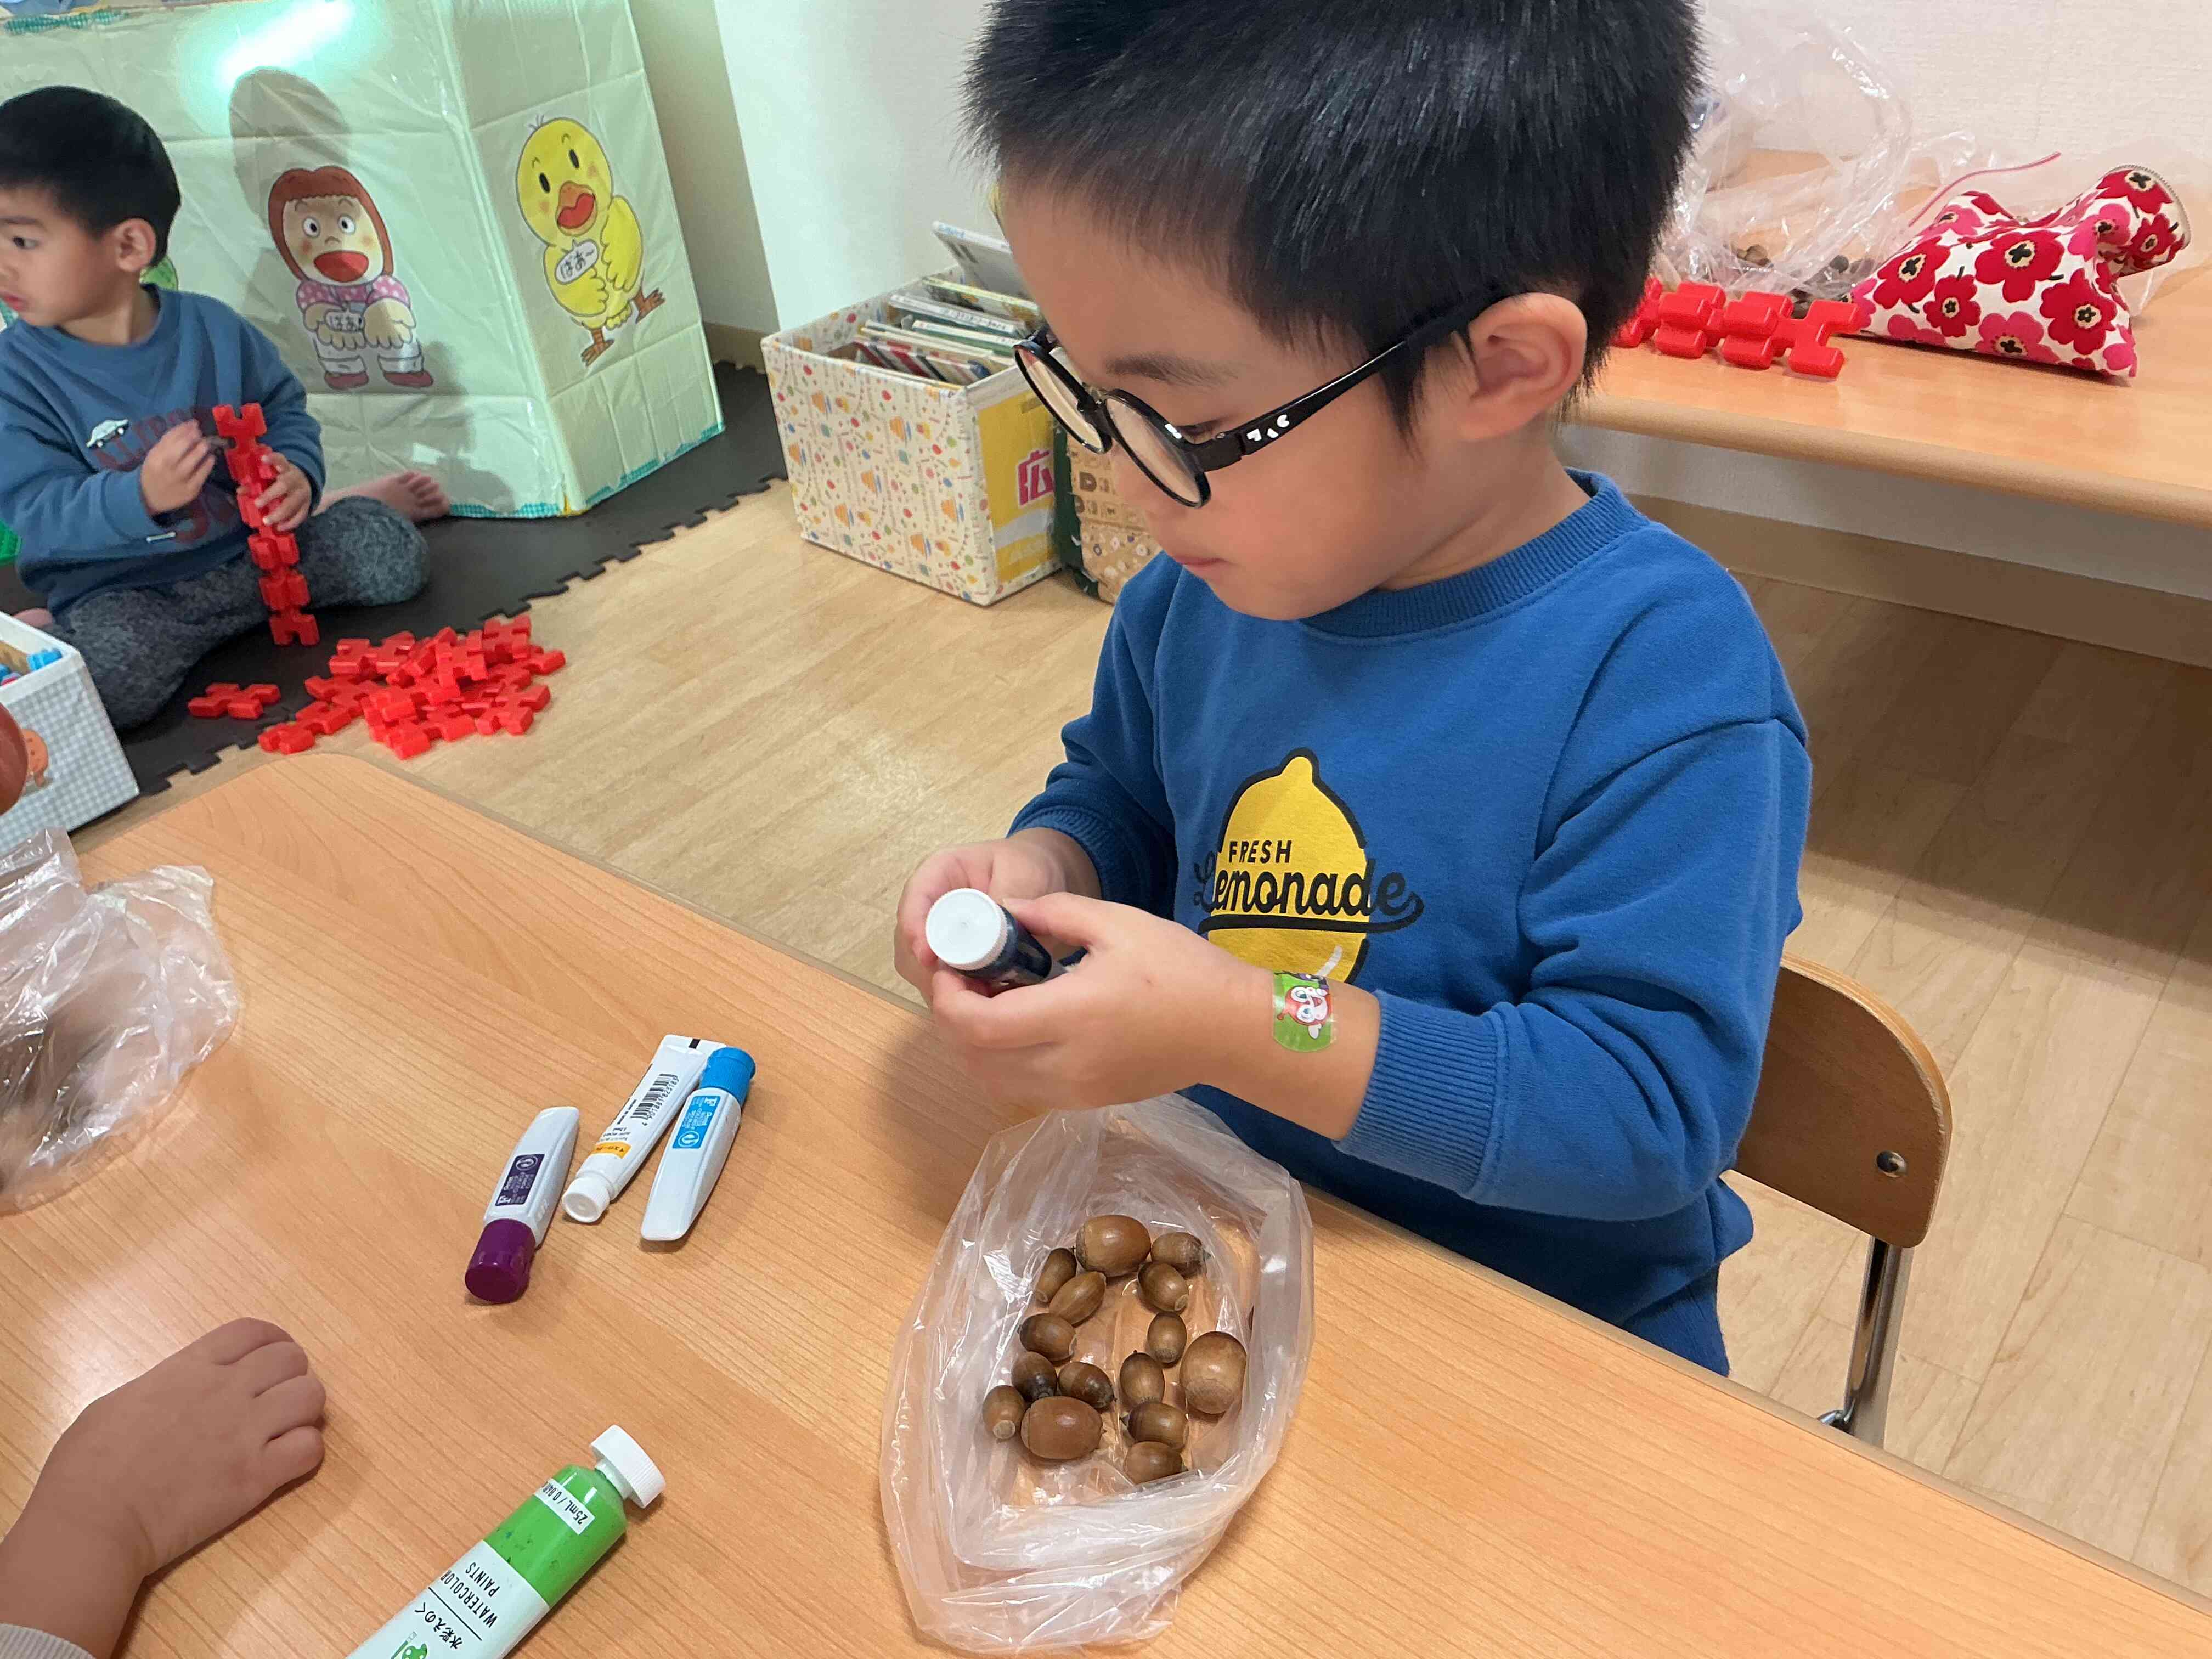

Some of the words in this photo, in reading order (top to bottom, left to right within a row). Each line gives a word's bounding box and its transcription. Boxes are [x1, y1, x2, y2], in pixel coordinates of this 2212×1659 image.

[1229, 840, 1292, 864] FRESH
[564, 1500, 588, 1525] 25mL
[465, 1562, 500, 1598] PAINTS
[441, 1570, 498, 1628] WATERCOLOR
[415, 1602, 462, 1649] 水彩えのく
